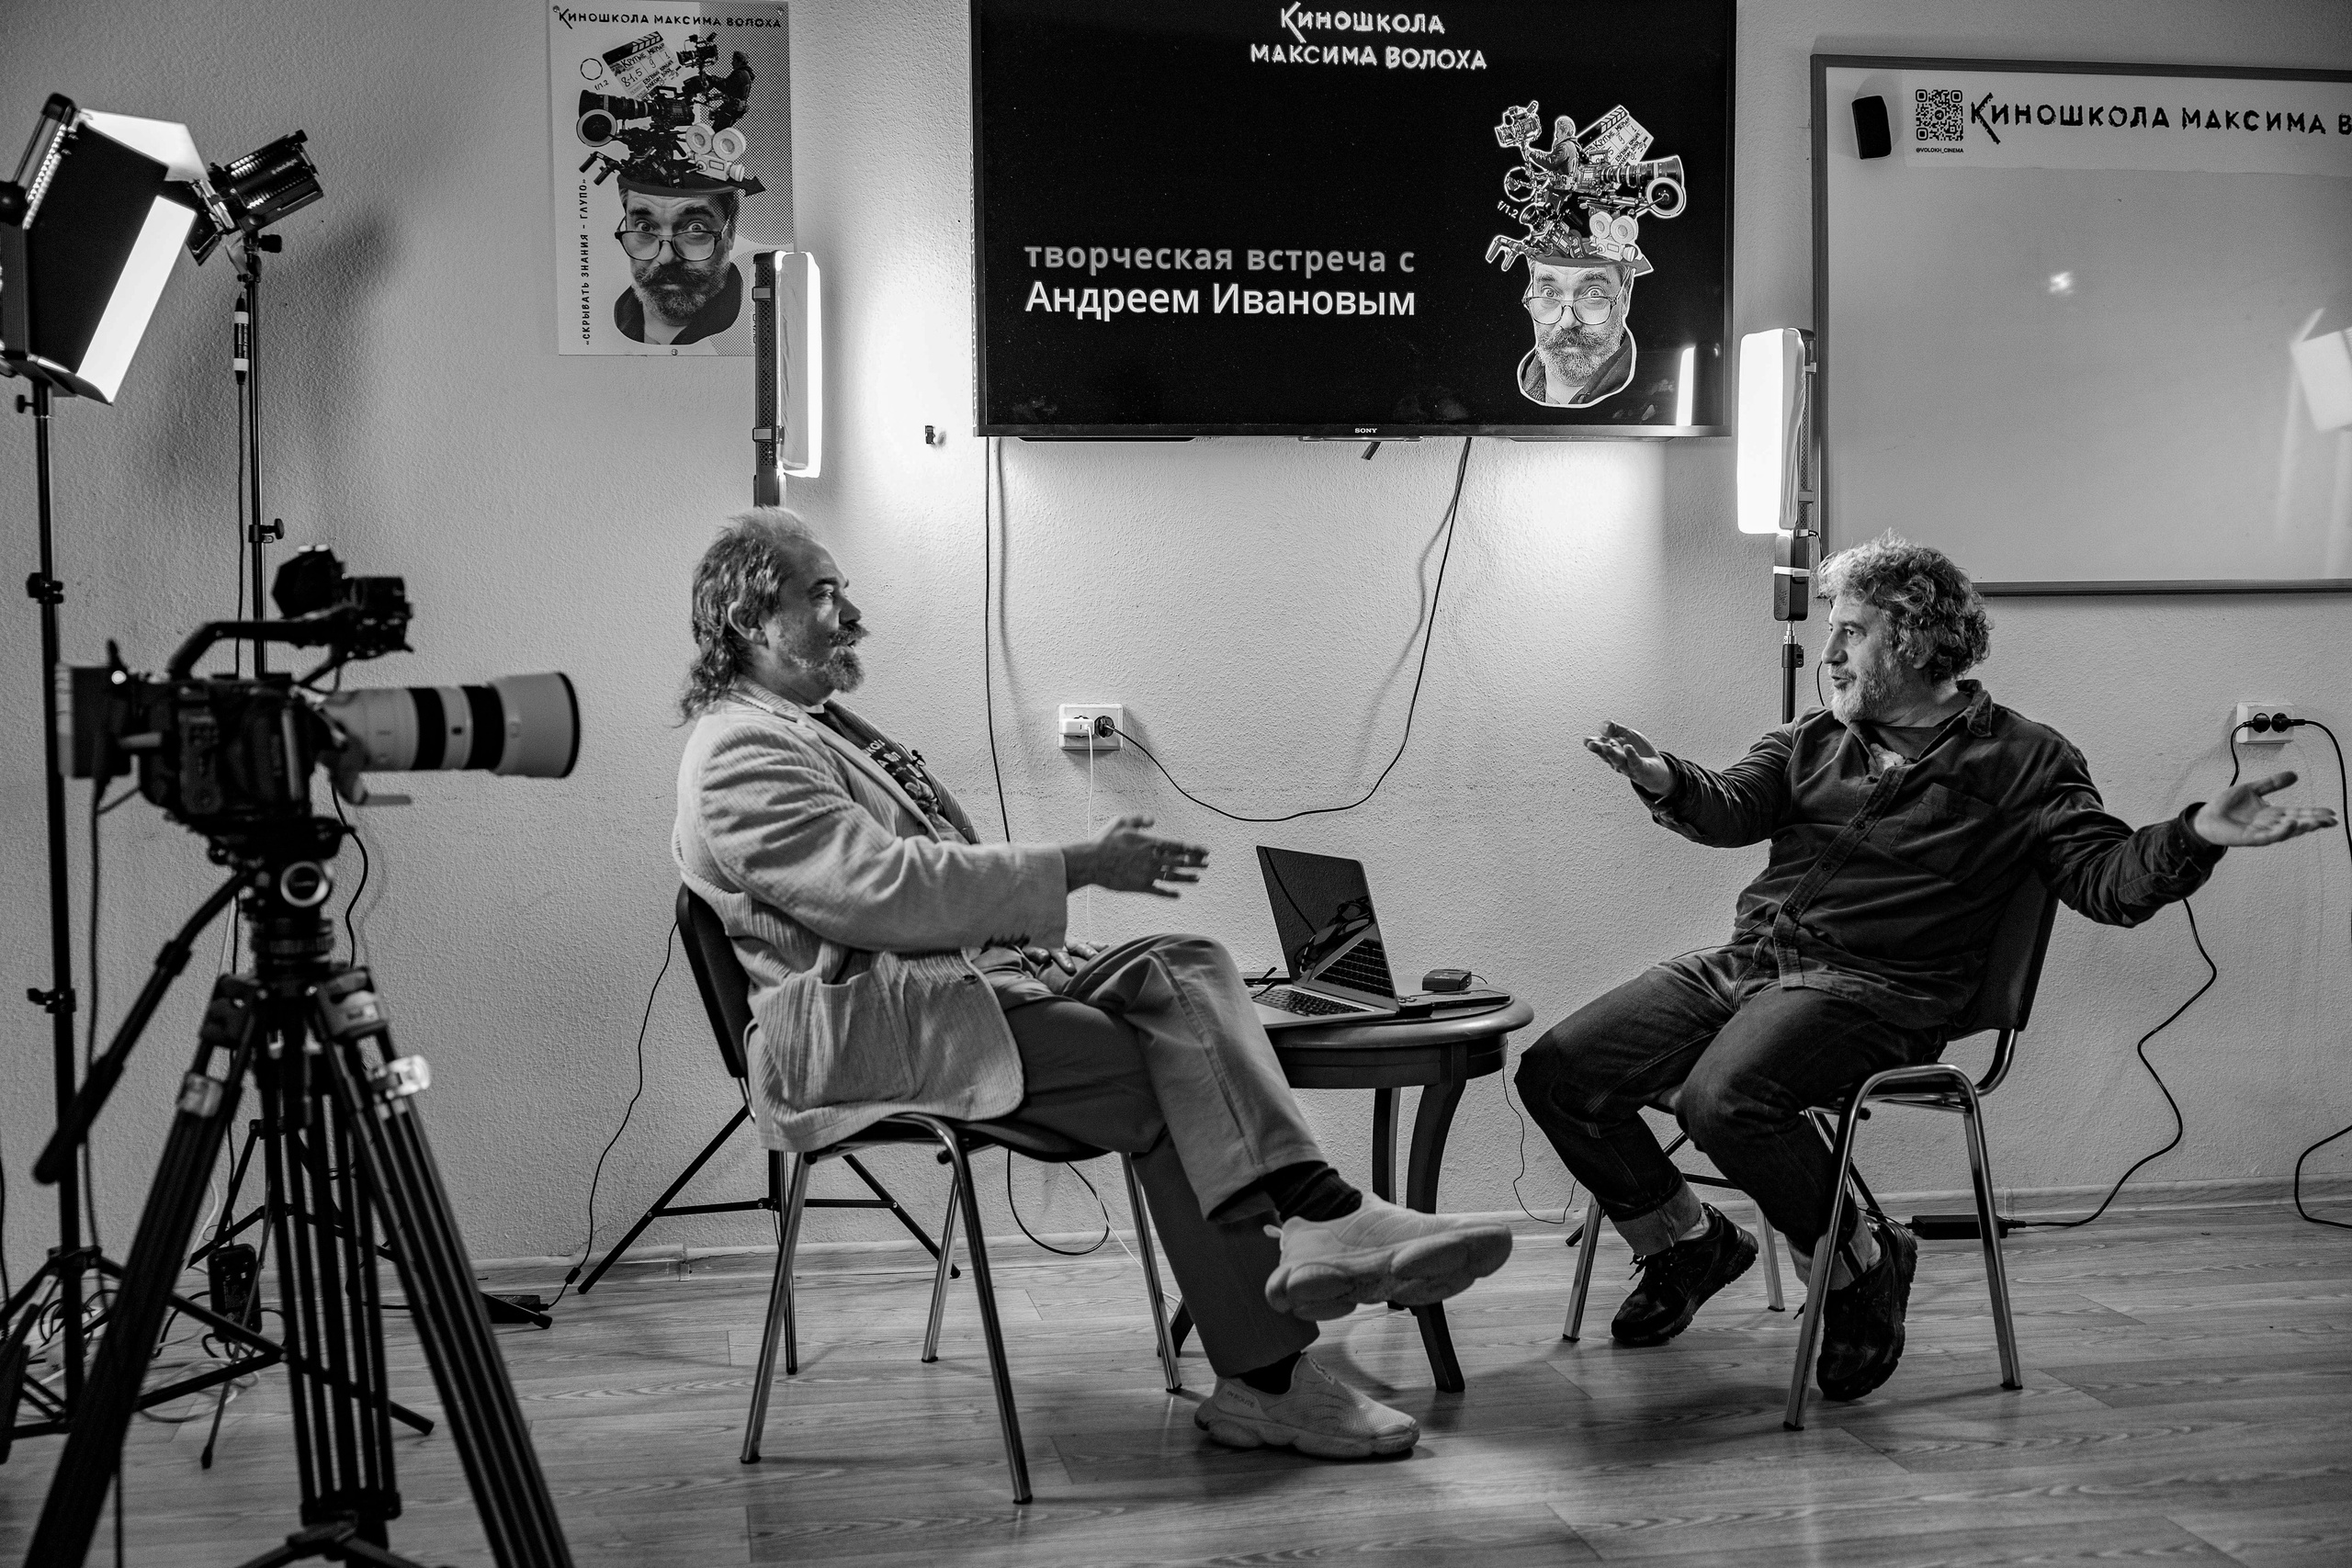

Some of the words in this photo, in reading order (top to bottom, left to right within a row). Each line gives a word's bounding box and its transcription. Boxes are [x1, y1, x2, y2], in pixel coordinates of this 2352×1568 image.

[654, 15, 721, 27] МАКСИМА
[727, 17, 782, 28] ВОЛОХА
[1250, 43, 1378, 66] МАКСИМА
[1385, 45, 1487, 70] ВОЛОХА
[2181, 107, 2326, 135] МАКСИМА
[1497, 200, 1519, 220] f/1.2
[580, 233, 590, 277] ЗНАНИЯ
[1024, 246, 1234, 279] творческая
[1247, 249, 1385, 279] встреча
[1399, 252, 1415, 273] с
[1024, 282, 1199, 322] Андреем
[1213, 283, 1415, 316] Ивановым
